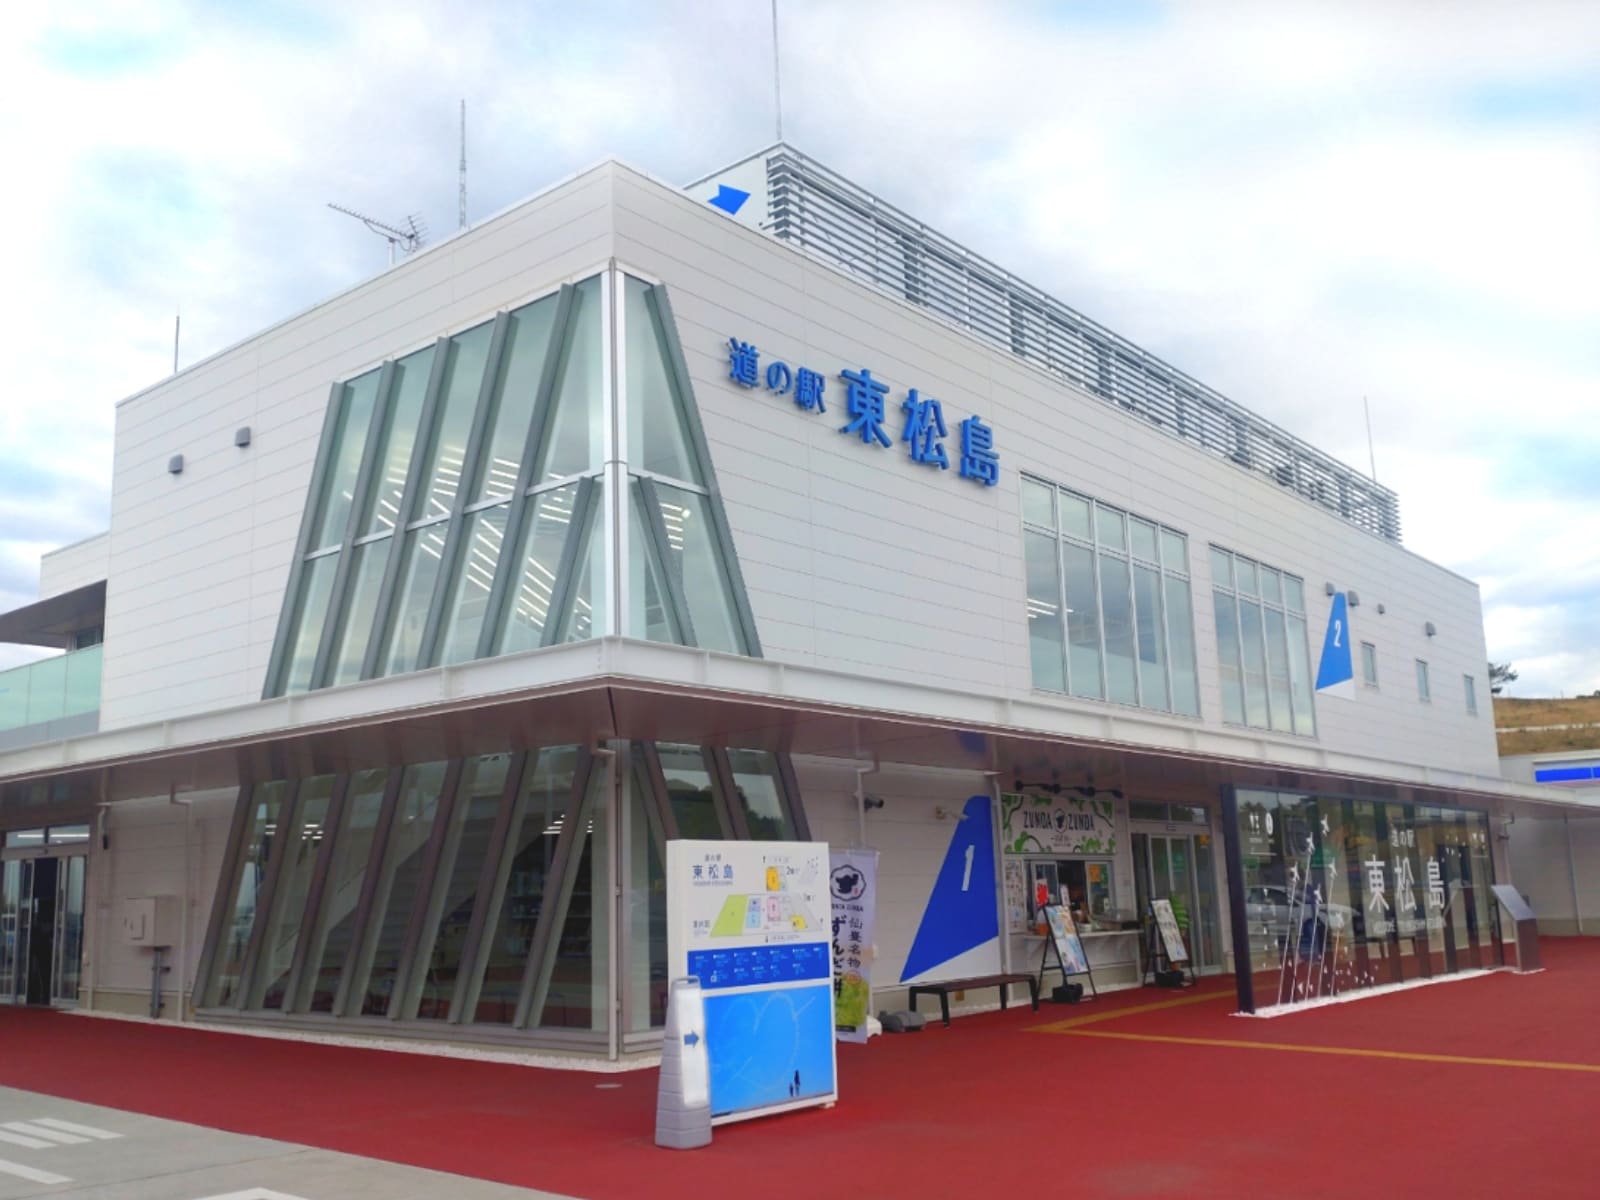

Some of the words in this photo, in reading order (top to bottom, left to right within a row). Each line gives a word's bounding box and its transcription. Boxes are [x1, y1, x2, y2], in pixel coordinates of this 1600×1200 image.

[725, 337, 826, 413] 道の駅
[838, 368, 1000, 487] 東松島
[1333, 619, 1342, 648] 2
[1023, 810, 1053, 829] ZUNDA
[692, 863, 734, 880] 東松島
[961, 845, 975, 892] 1
[1364, 853, 1446, 913] 東松島
